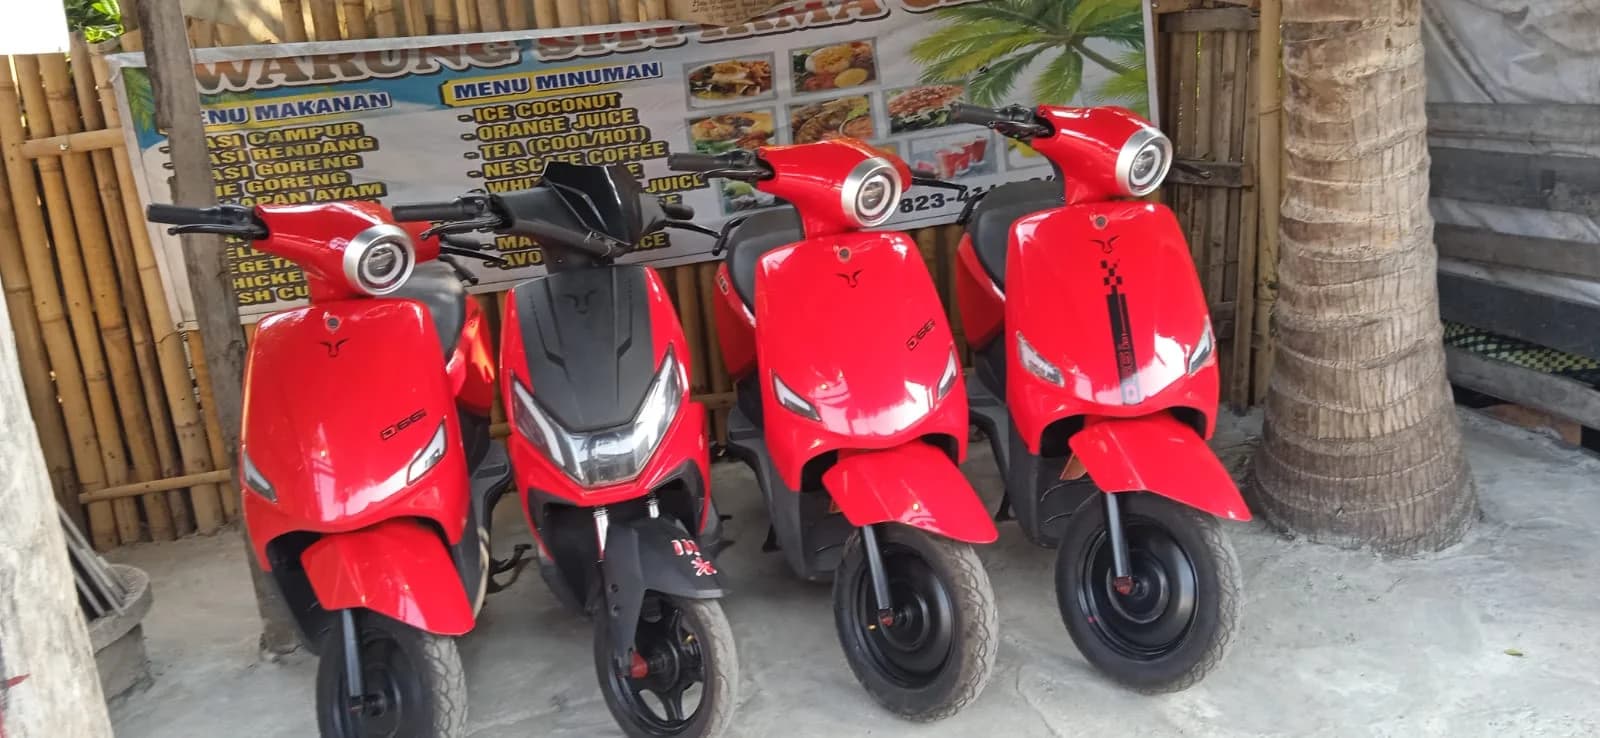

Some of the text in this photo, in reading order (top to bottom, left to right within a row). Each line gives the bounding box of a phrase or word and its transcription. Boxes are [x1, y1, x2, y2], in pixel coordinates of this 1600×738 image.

[454, 62, 661, 99] MENU MINUMAN
[255, 93, 390, 121] MAKANAN
[475, 94, 621, 122] ICE COCONUT
[206, 123, 360, 149] ASI CAMPUR
[477, 109, 637, 141] ORANGE JUICE
[209, 137, 376, 166] ASI RENDANG
[481, 126, 648, 161] TEA (COOL/HOT)
[588, 142, 667, 164] COFFEE
[211, 154, 359, 181] ASI GORENG
[215, 172, 348, 198] IE GORENG
[315, 183, 383, 201] AYAM
[233, 271, 302, 289] HICKE
[238, 290, 271, 304] SH
